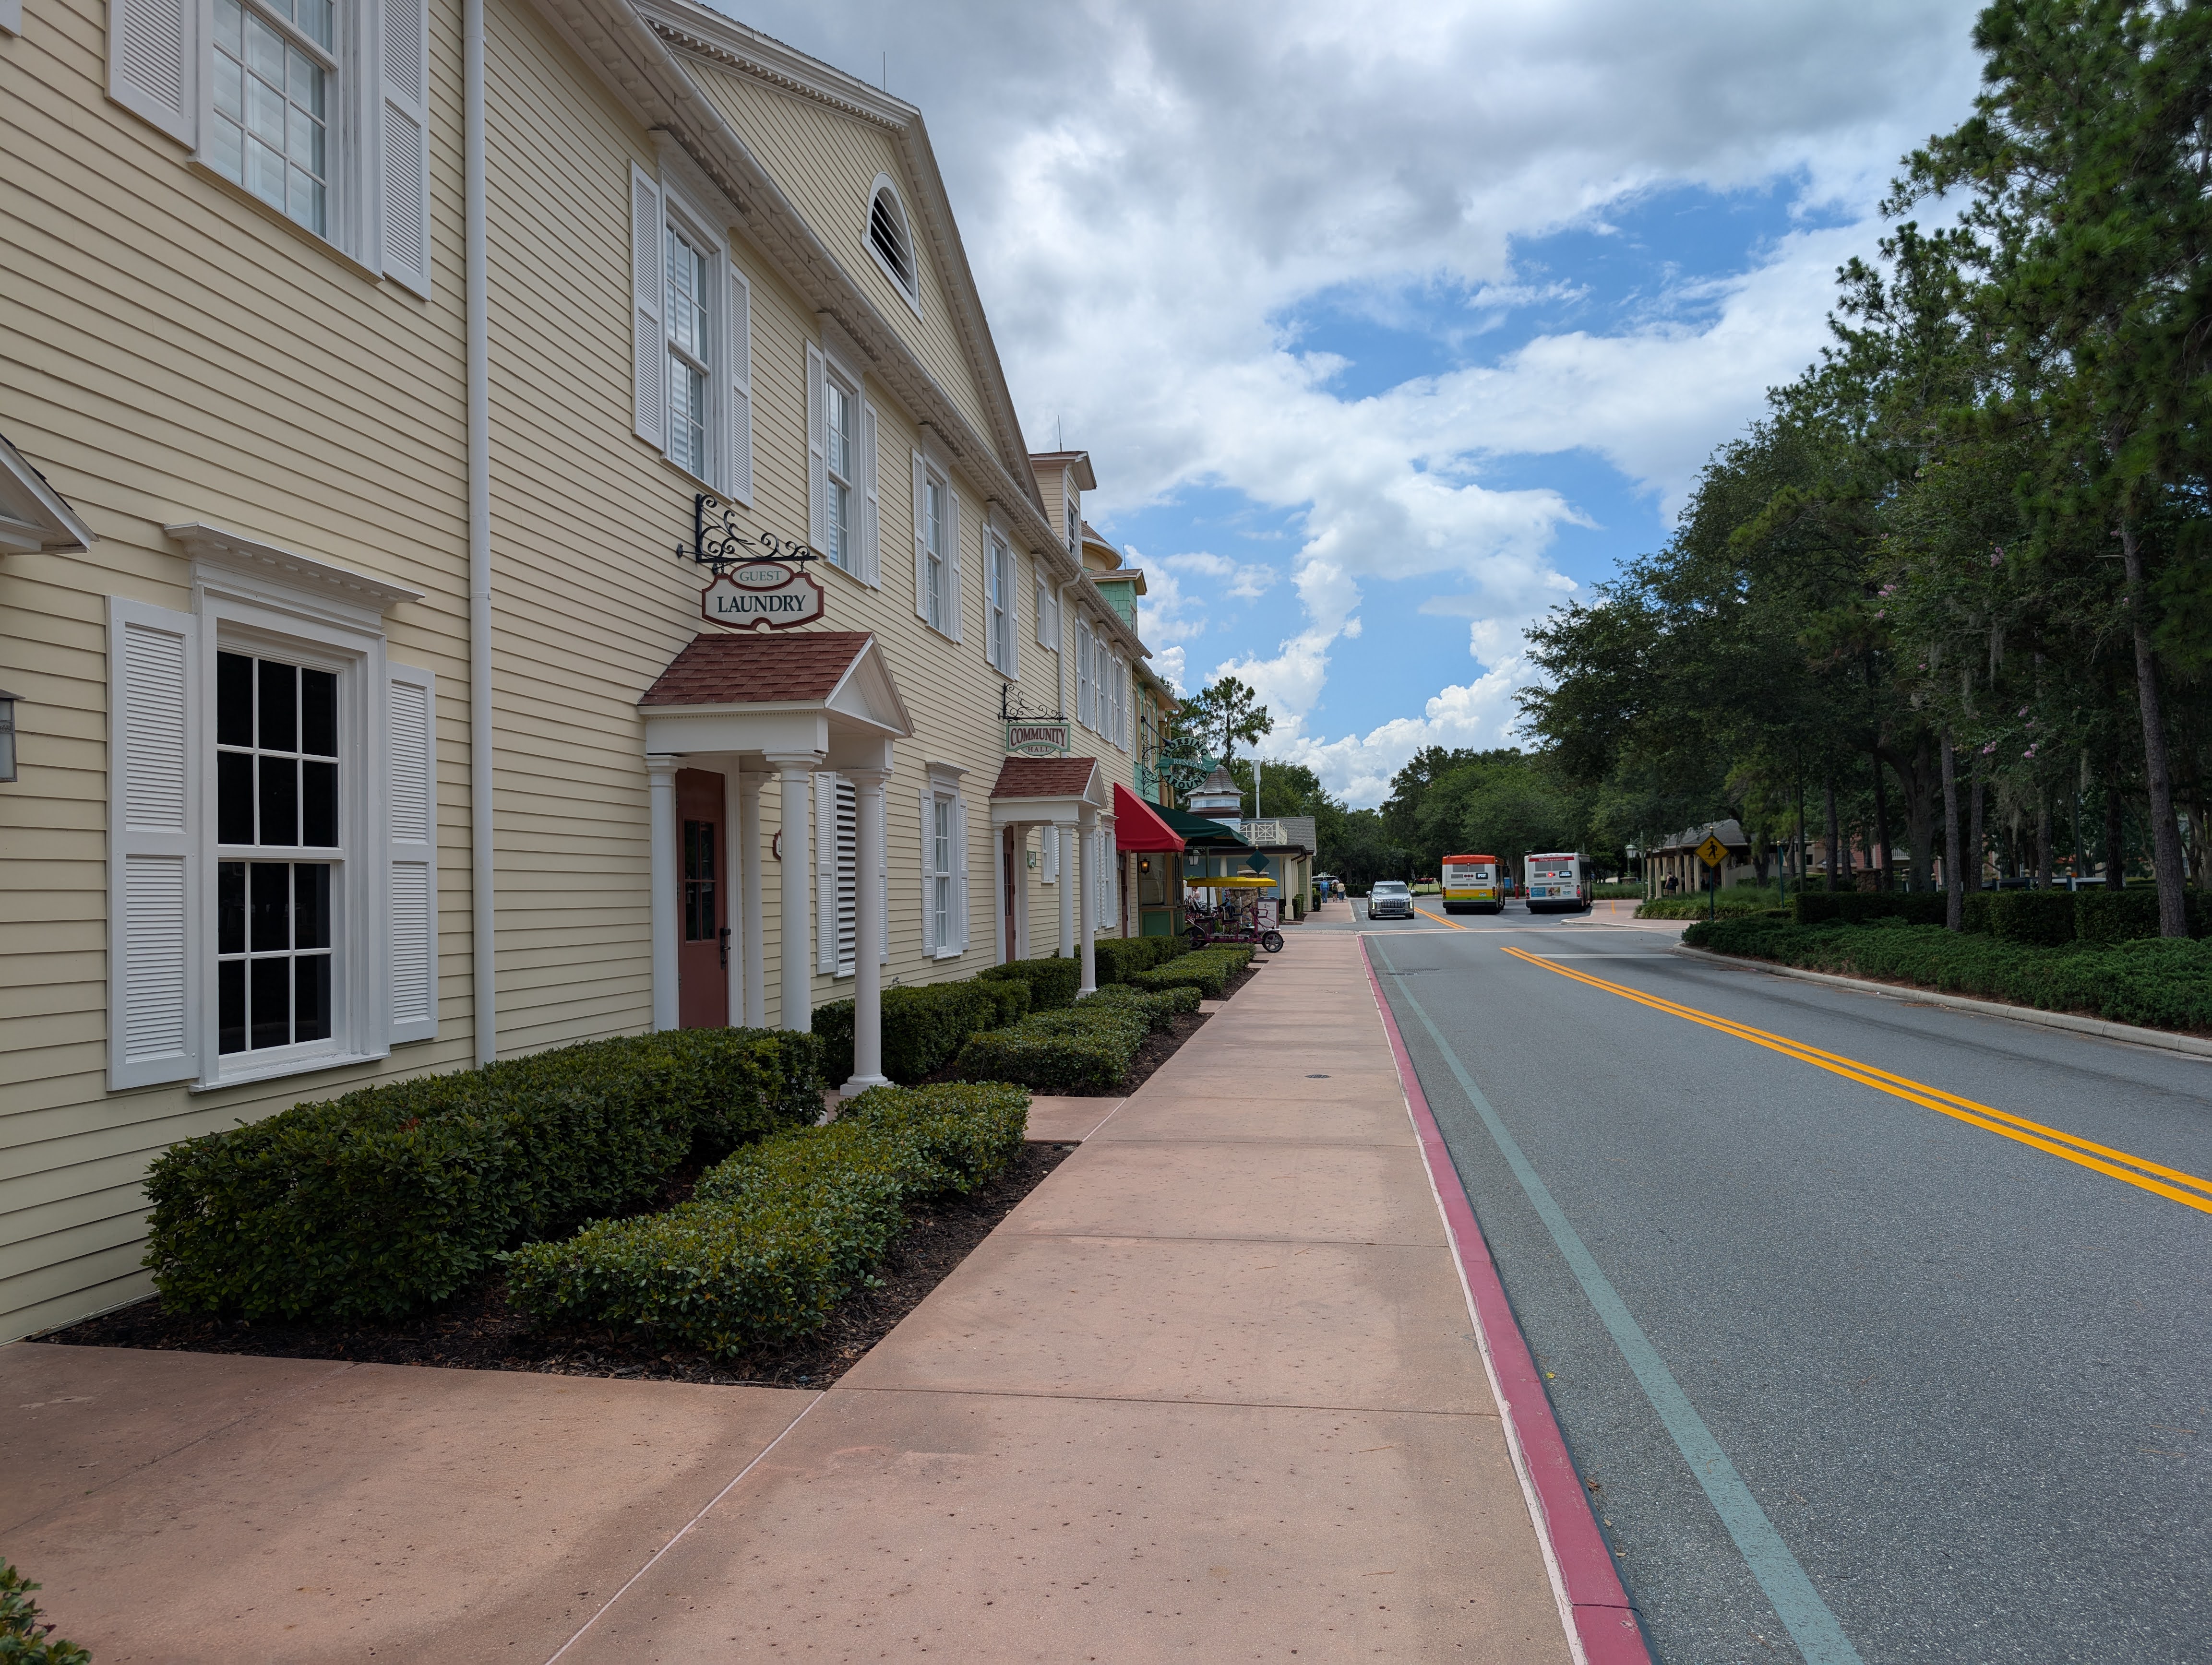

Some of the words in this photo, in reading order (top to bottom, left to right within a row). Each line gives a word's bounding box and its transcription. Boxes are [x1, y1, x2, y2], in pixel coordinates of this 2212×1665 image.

[740, 571, 782, 582] GUEST
[717, 595, 806, 613] LAUNDRY
[1010, 728, 1066, 747] COMMUNITY
[1162, 737, 1208, 758] HORSING
[1173, 759, 1207, 771] RENTALS
[1164, 772, 1207, 789] AROUND
